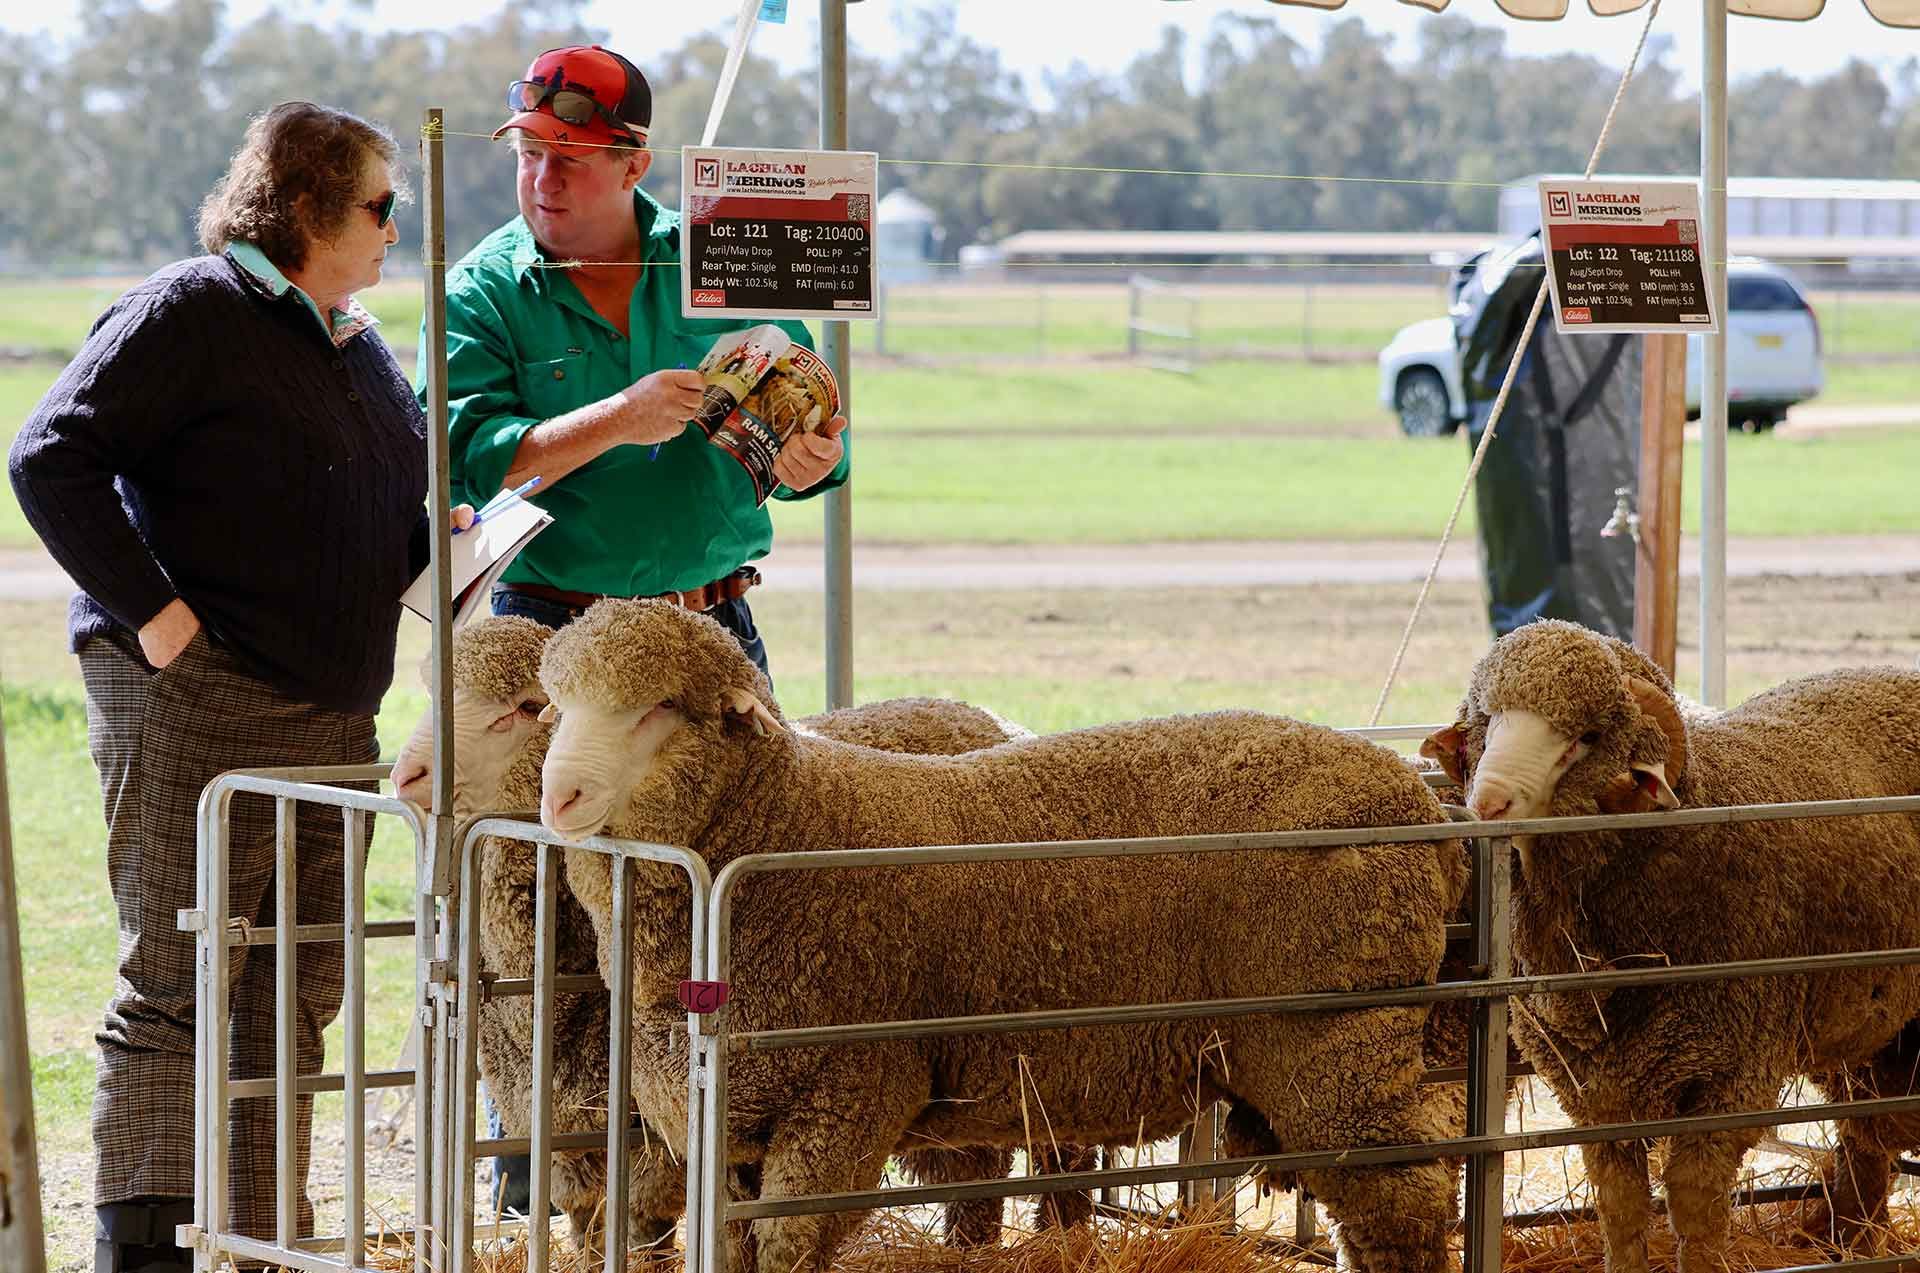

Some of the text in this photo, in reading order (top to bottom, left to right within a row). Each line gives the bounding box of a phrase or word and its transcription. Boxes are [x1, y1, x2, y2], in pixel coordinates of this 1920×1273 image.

[726, 162, 806, 175] LACHLAN
[726, 175, 806, 188] MERINOS
[1576, 193, 1640, 204] LACHLAN
[1578, 205, 1642, 216] MERINOS
[710, 224, 864, 242] Lot: 121 Tag: 210400
[706, 245, 772, 257] April/May Drop
[806, 248, 843, 258] POLL: PP
[1569, 248, 1695, 264] Lot: 122 Tag: 211188
[702, 262, 776, 274] Rear Type: Single
[791, 264, 859, 275] EMD (mm): 41.0
[1570, 267, 1623, 278] Aug/Sept Drop
[1650, 269, 1669, 277] POLL:
[701, 277, 778, 290] Body Wt: 102.5kg
[796, 279, 854, 291] FAT (mm): 6.0
[1567, 282, 1630, 292] Rear Type: Single
[1658, 283, 1678, 293] (mm):
[1568, 296, 1633, 307] Body Wt: 102.5kg
[1647, 297, 1660, 305] FAT
[1661, 296, 1682, 307] (mm):
[741, 418, 769, 443] RAM
